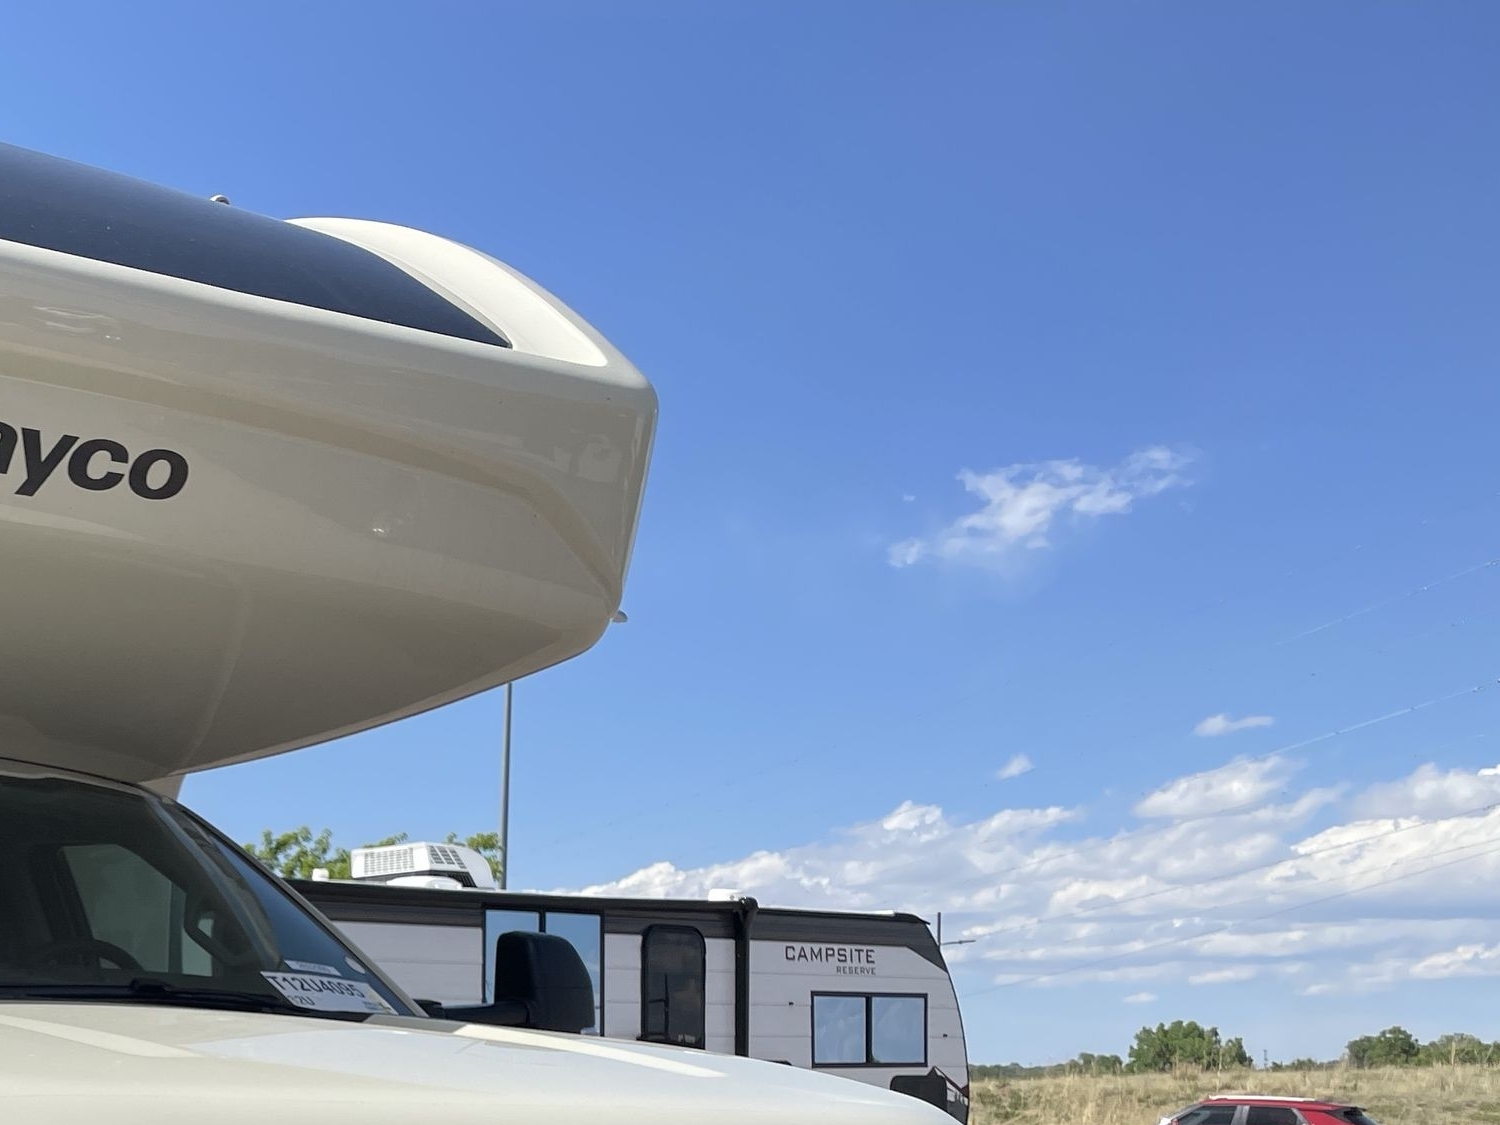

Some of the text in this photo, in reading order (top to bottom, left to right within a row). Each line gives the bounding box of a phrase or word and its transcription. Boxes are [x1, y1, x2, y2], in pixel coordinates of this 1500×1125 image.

[785, 946, 876, 964] CAMPSITE
[836, 966, 876, 975] RESERVE
[267, 976, 366, 998] T12U4095
